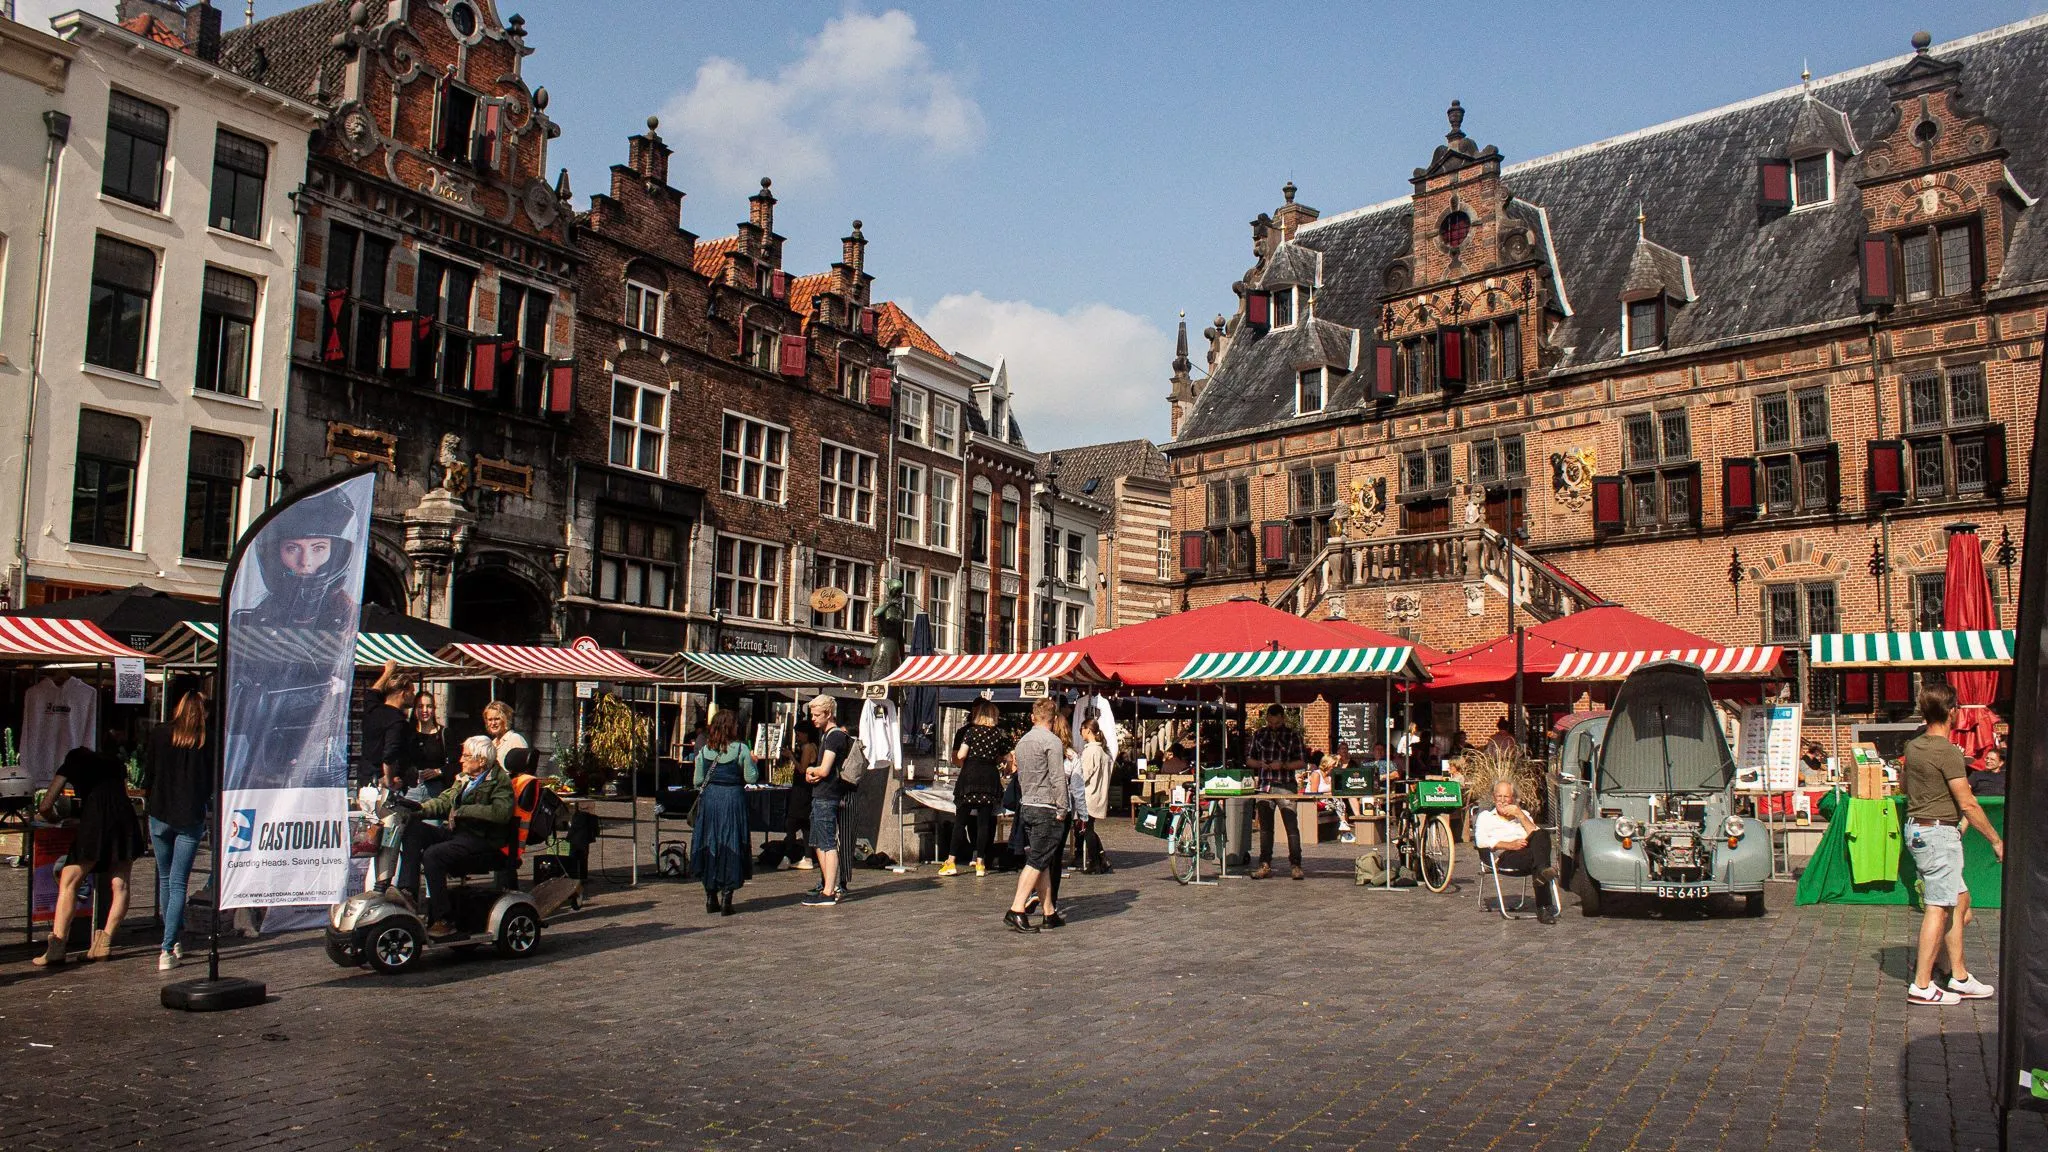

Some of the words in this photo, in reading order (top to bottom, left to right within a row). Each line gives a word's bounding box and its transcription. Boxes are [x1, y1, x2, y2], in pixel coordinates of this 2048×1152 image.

[734, 636, 763, 654] Hertog
[762, 639, 778, 655] Jan
[1425, 794, 1457, 802] Heineken
[258, 820, 342, 851] CASTODIAN
[227, 860, 260, 869] Guarding
[261, 858, 290, 867] Heads.
[291, 857, 320, 866] Saving
[321, 856, 344, 865] Lives.
